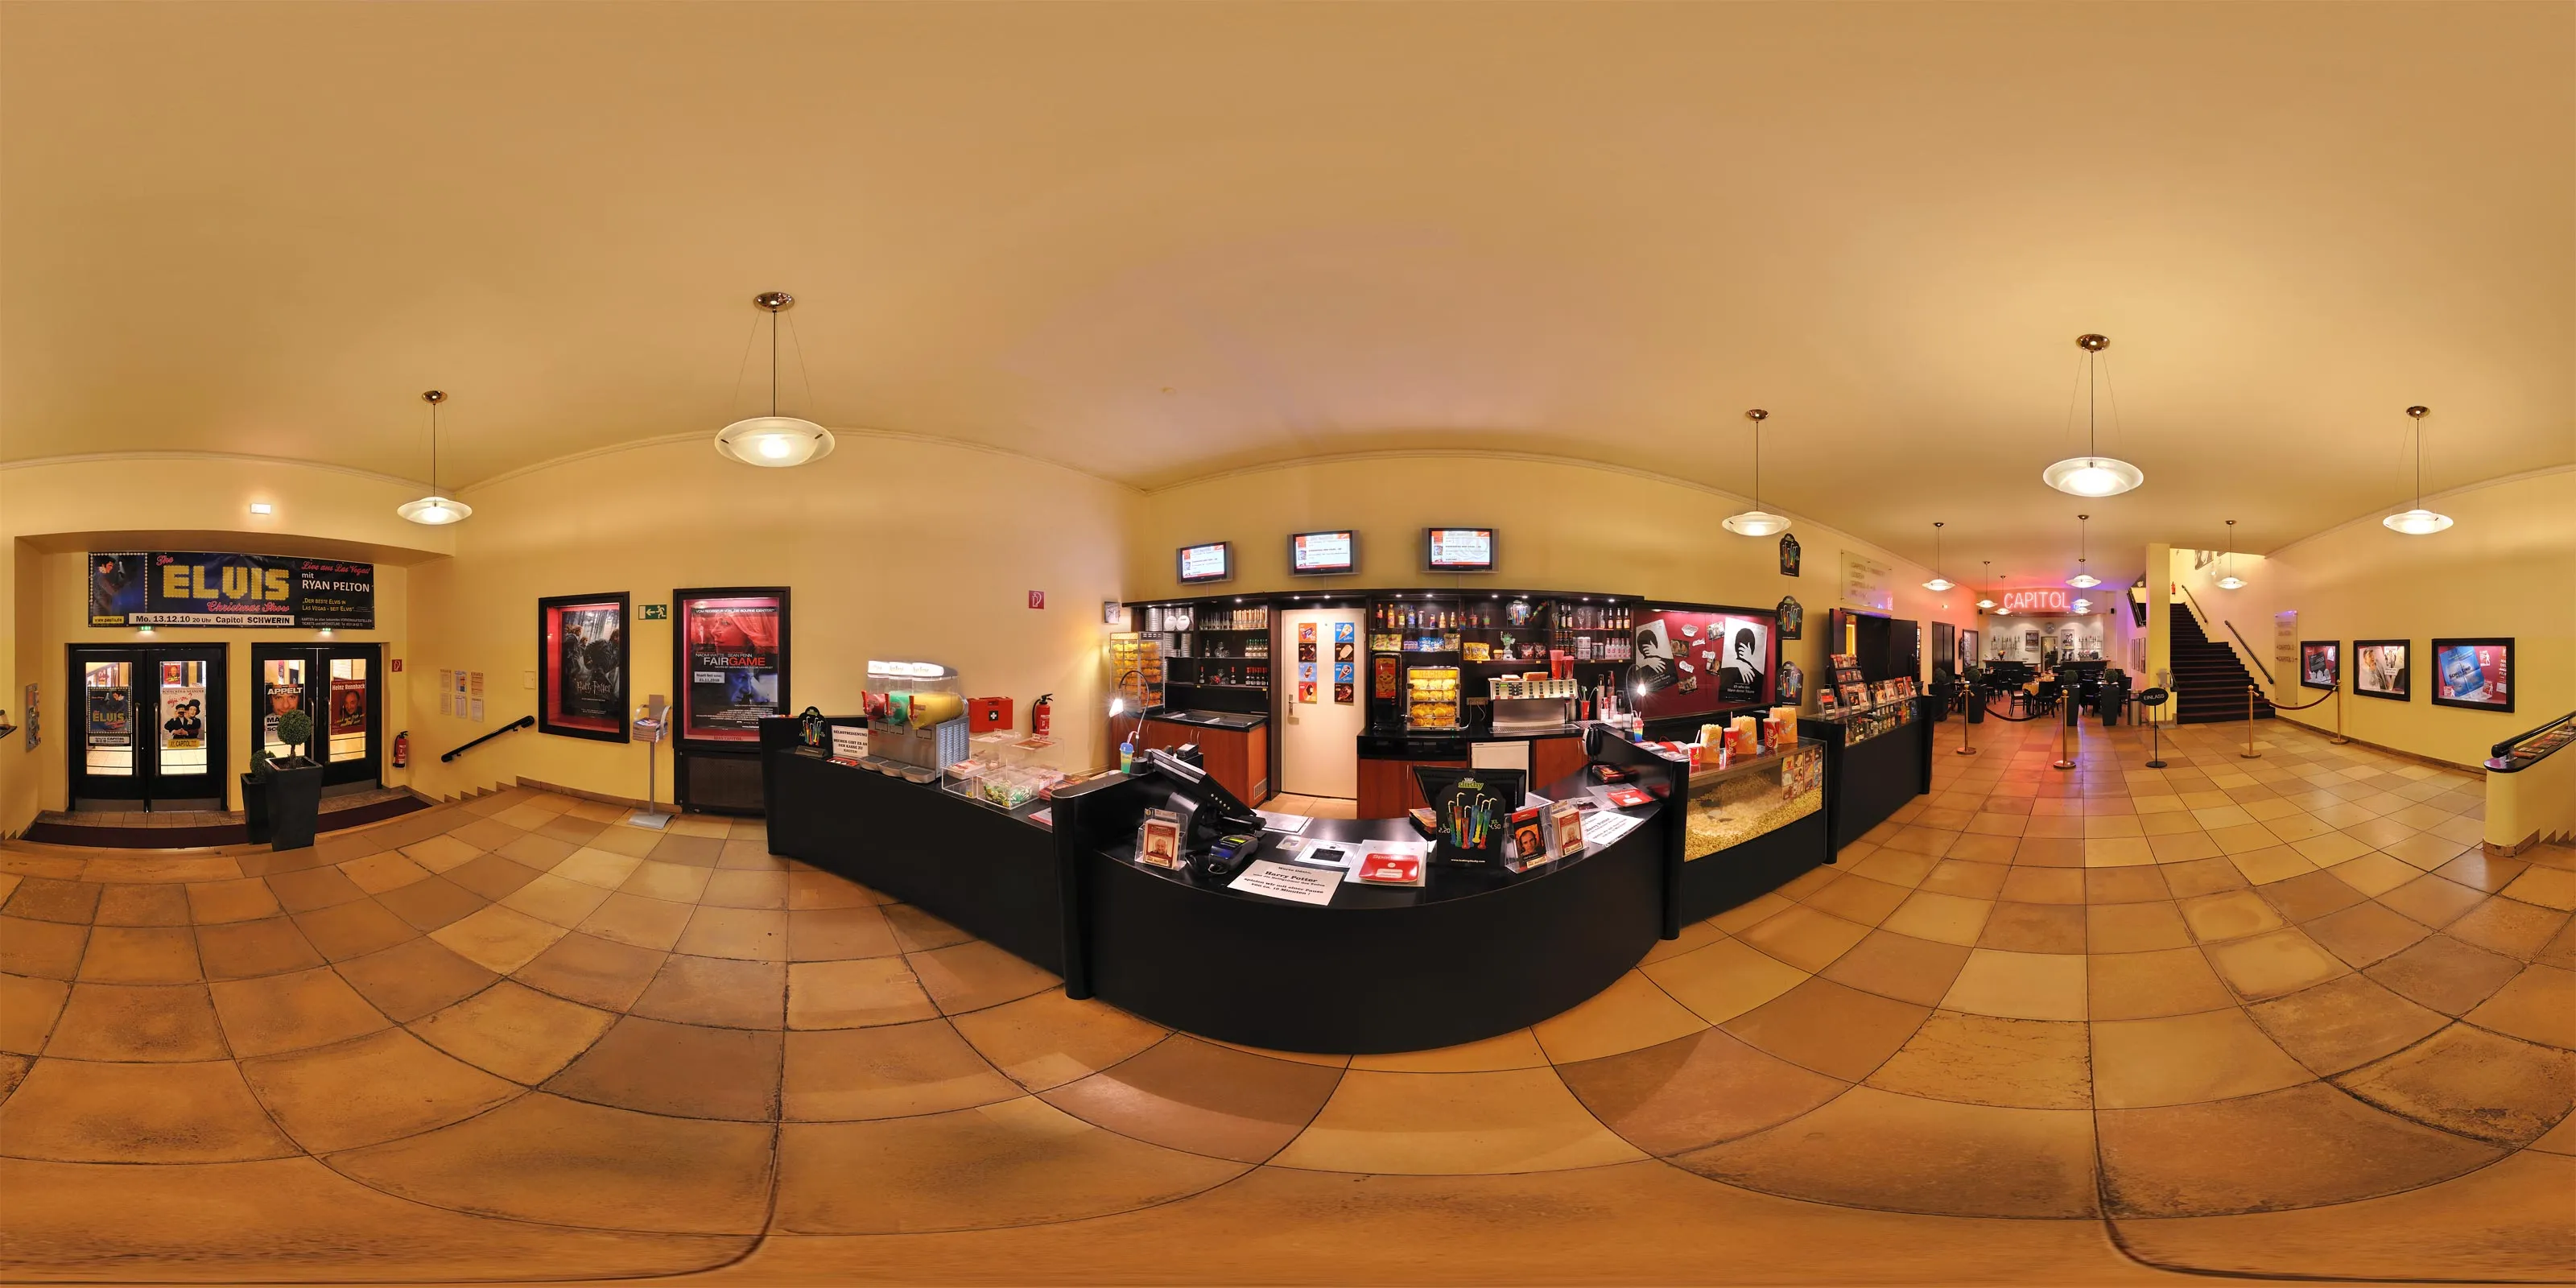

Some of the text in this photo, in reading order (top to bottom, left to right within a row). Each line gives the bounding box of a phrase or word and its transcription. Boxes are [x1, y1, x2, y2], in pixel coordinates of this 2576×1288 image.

[156, 555, 174, 566] The
[301, 560, 319, 570] Live
[334, 564, 349, 573] Las
[349, 565, 371, 576] Vegas!
[163, 565, 290, 601] ELVIS
[302, 580, 369, 592] RYAN PELTON
[2004, 592, 2070, 609] CAPITOL
[206, 601, 290, 612] Christmas Show
[267, 687, 303, 695] APPELT
[93, 712, 125, 722] ELVIS
[1458, 781, 1484, 791] slushy
[1265, 870, 1290, 879] Harry
